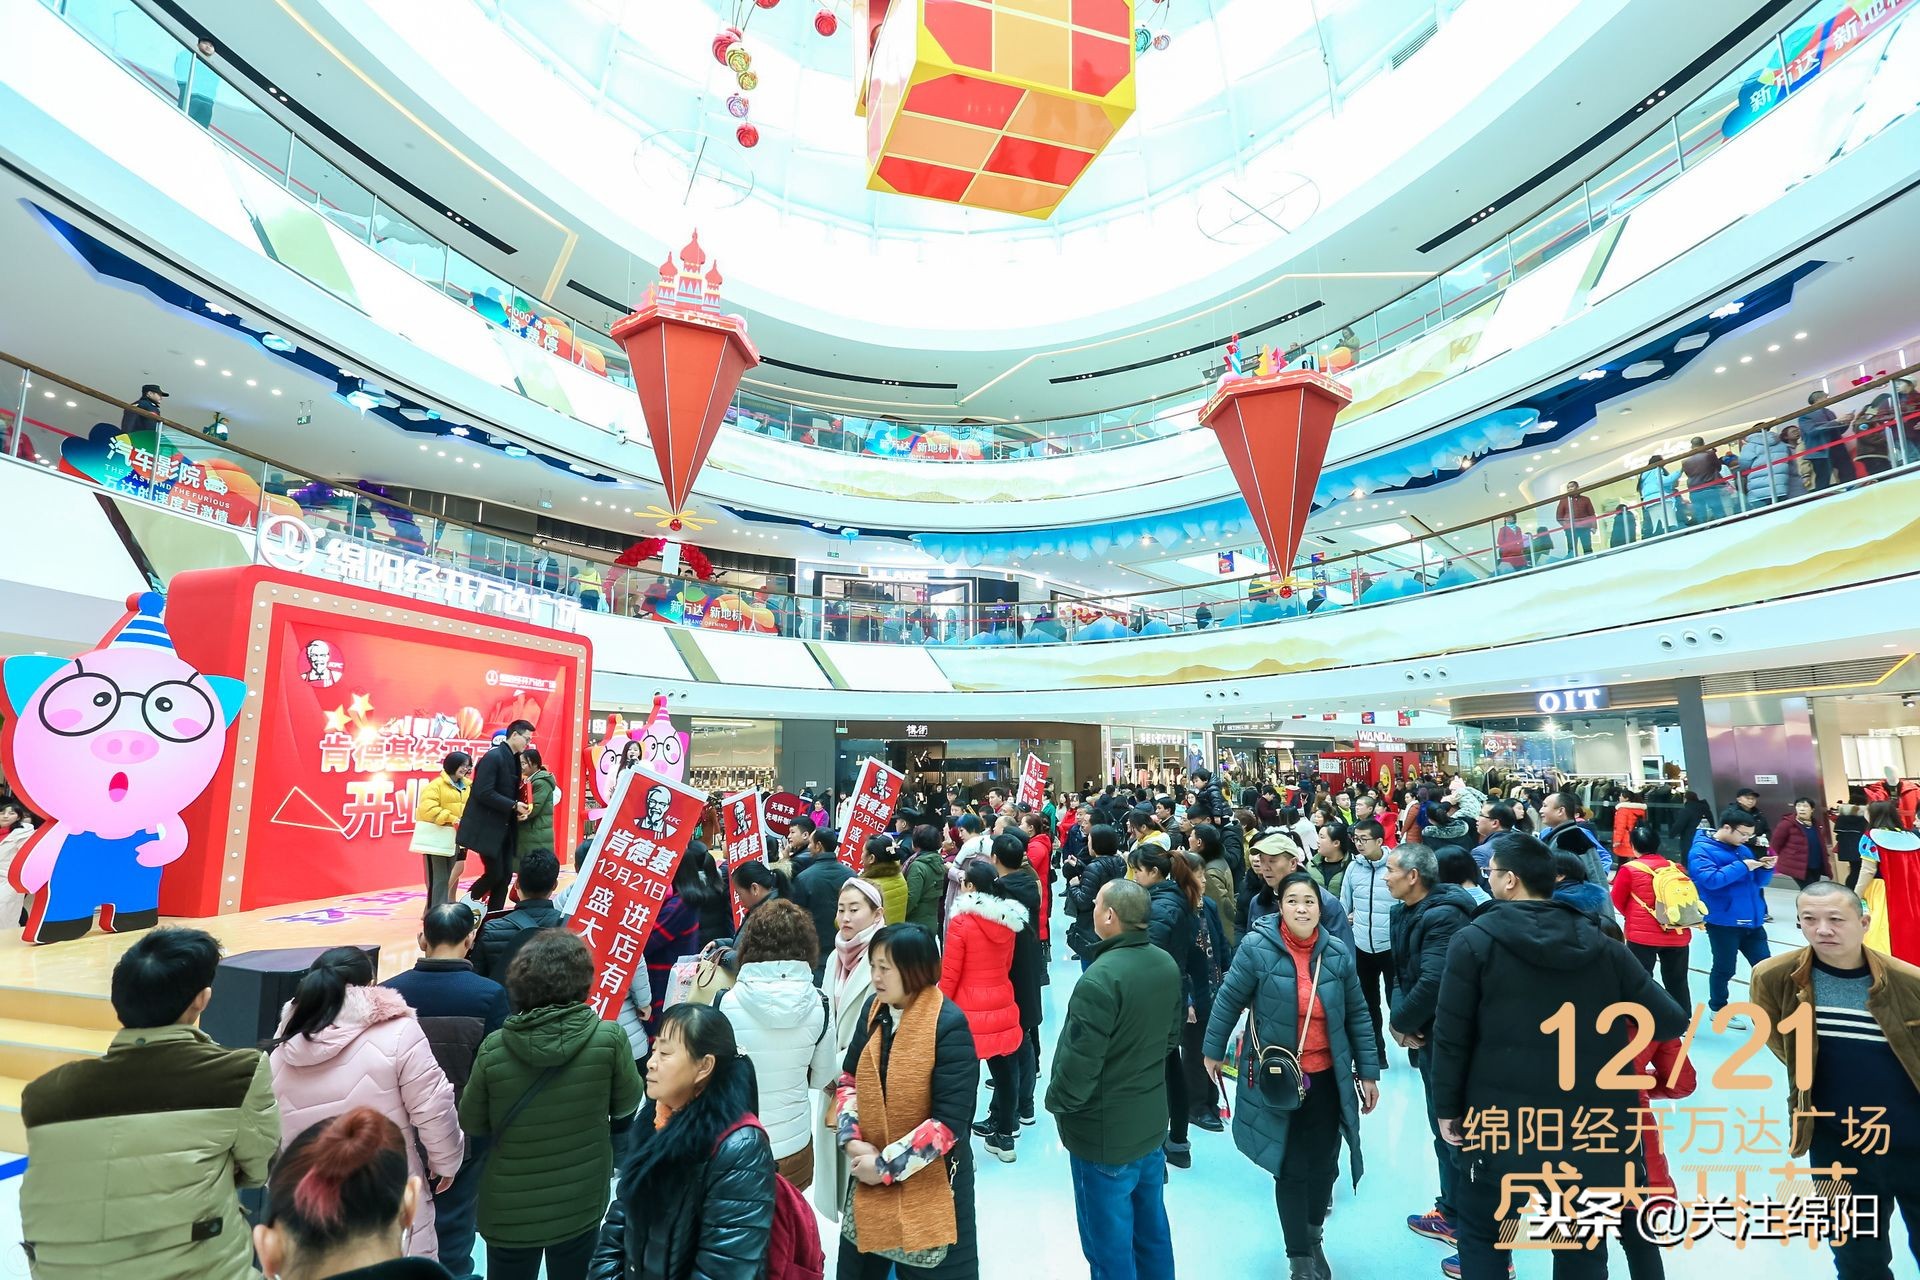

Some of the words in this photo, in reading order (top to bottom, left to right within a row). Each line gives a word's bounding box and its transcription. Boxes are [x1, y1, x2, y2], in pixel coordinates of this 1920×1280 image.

[108, 436, 201, 487] 汽车影院
[103, 474, 230, 524] 万达的速度与激情
[104, 463, 124, 474] THE
[126, 470, 150, 484] FAST
[154, 480, 172, 491] AND
[174, 485, 190, 497] THE
[192, 489, 231, 509] FURIOUS
[321, 536, 582, 627] 绵阳经开万达广场
[670, 600, 704, 617] 新万达
[709, 606, 743, 622] 新地标
[1538, 689, 1601, 713] OIT
[1140, 732, 1182, 744] SELECTED
[1358, 730, 1393, 742] WANDA
[665, 814, 682, 826] KFC
[852, 809, 886, 833] 12月21日
[856, 793, 892, 820] 肯德基
[604, 827, 678, 877] 肯德基
[728, 832, 760, 864] 肯德基
[597, 858, 667, 901] 12月21日
[590, 900, 651, 1021] 进店有礼
